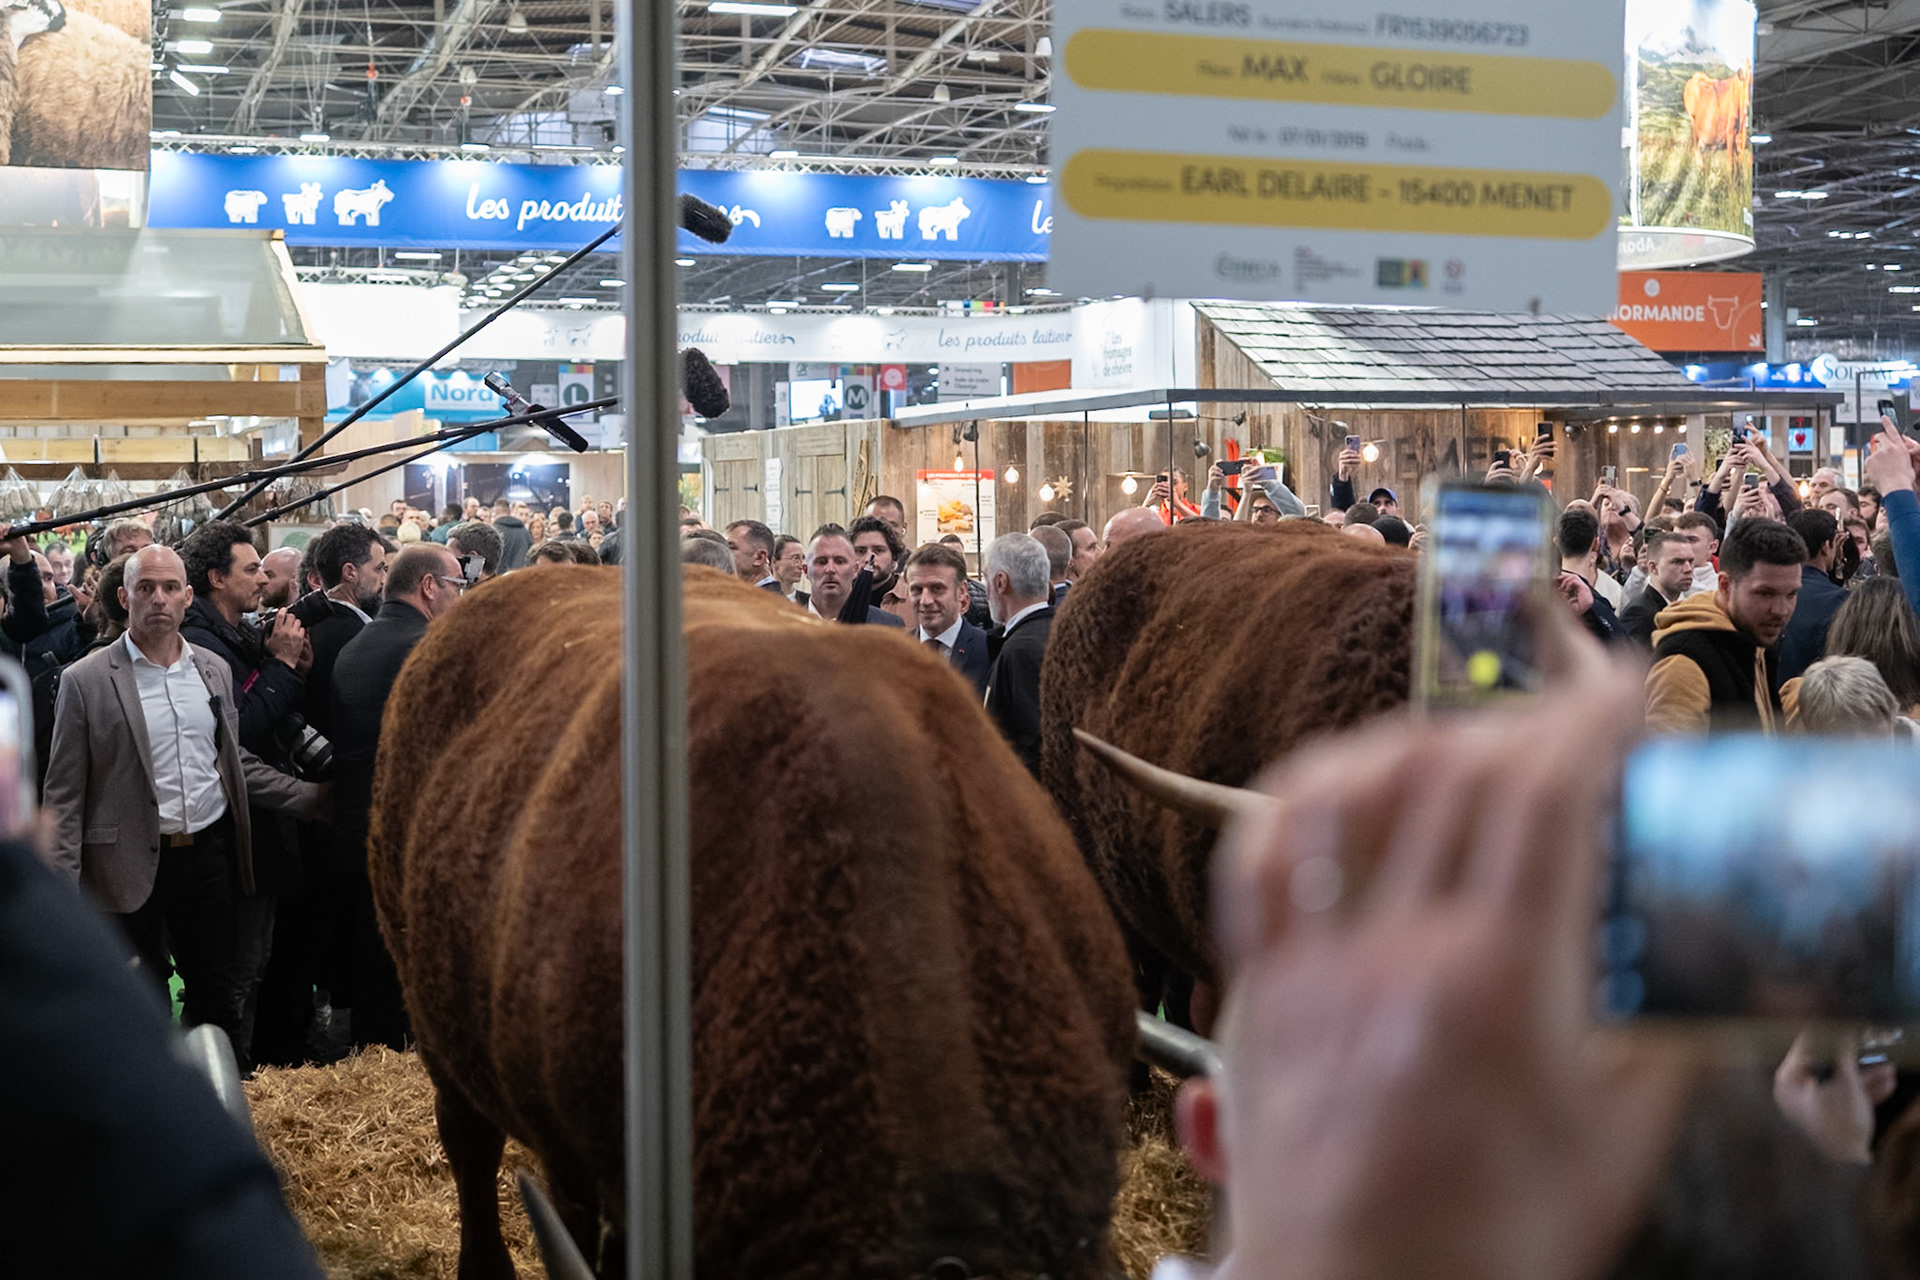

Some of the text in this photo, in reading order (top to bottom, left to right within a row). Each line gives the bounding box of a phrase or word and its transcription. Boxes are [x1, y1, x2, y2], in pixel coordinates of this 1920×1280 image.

[1163, 1, 1251, 27] SALERS
[1241, 55, 1309, 83] MAX
[1370, 62, 1473, 94] GLOIRE
[1180, 165, 1250, 197] EARL
[1257, 169, 1371, 203] DELAIRE
[1398, 178, 1475, 207] 15400
[1481, 181, 1576, 212] MENET
[517, 192, 624, 231] produit
[965, 332, 1027, 352] produits
[847, 388, 866, 405] M
